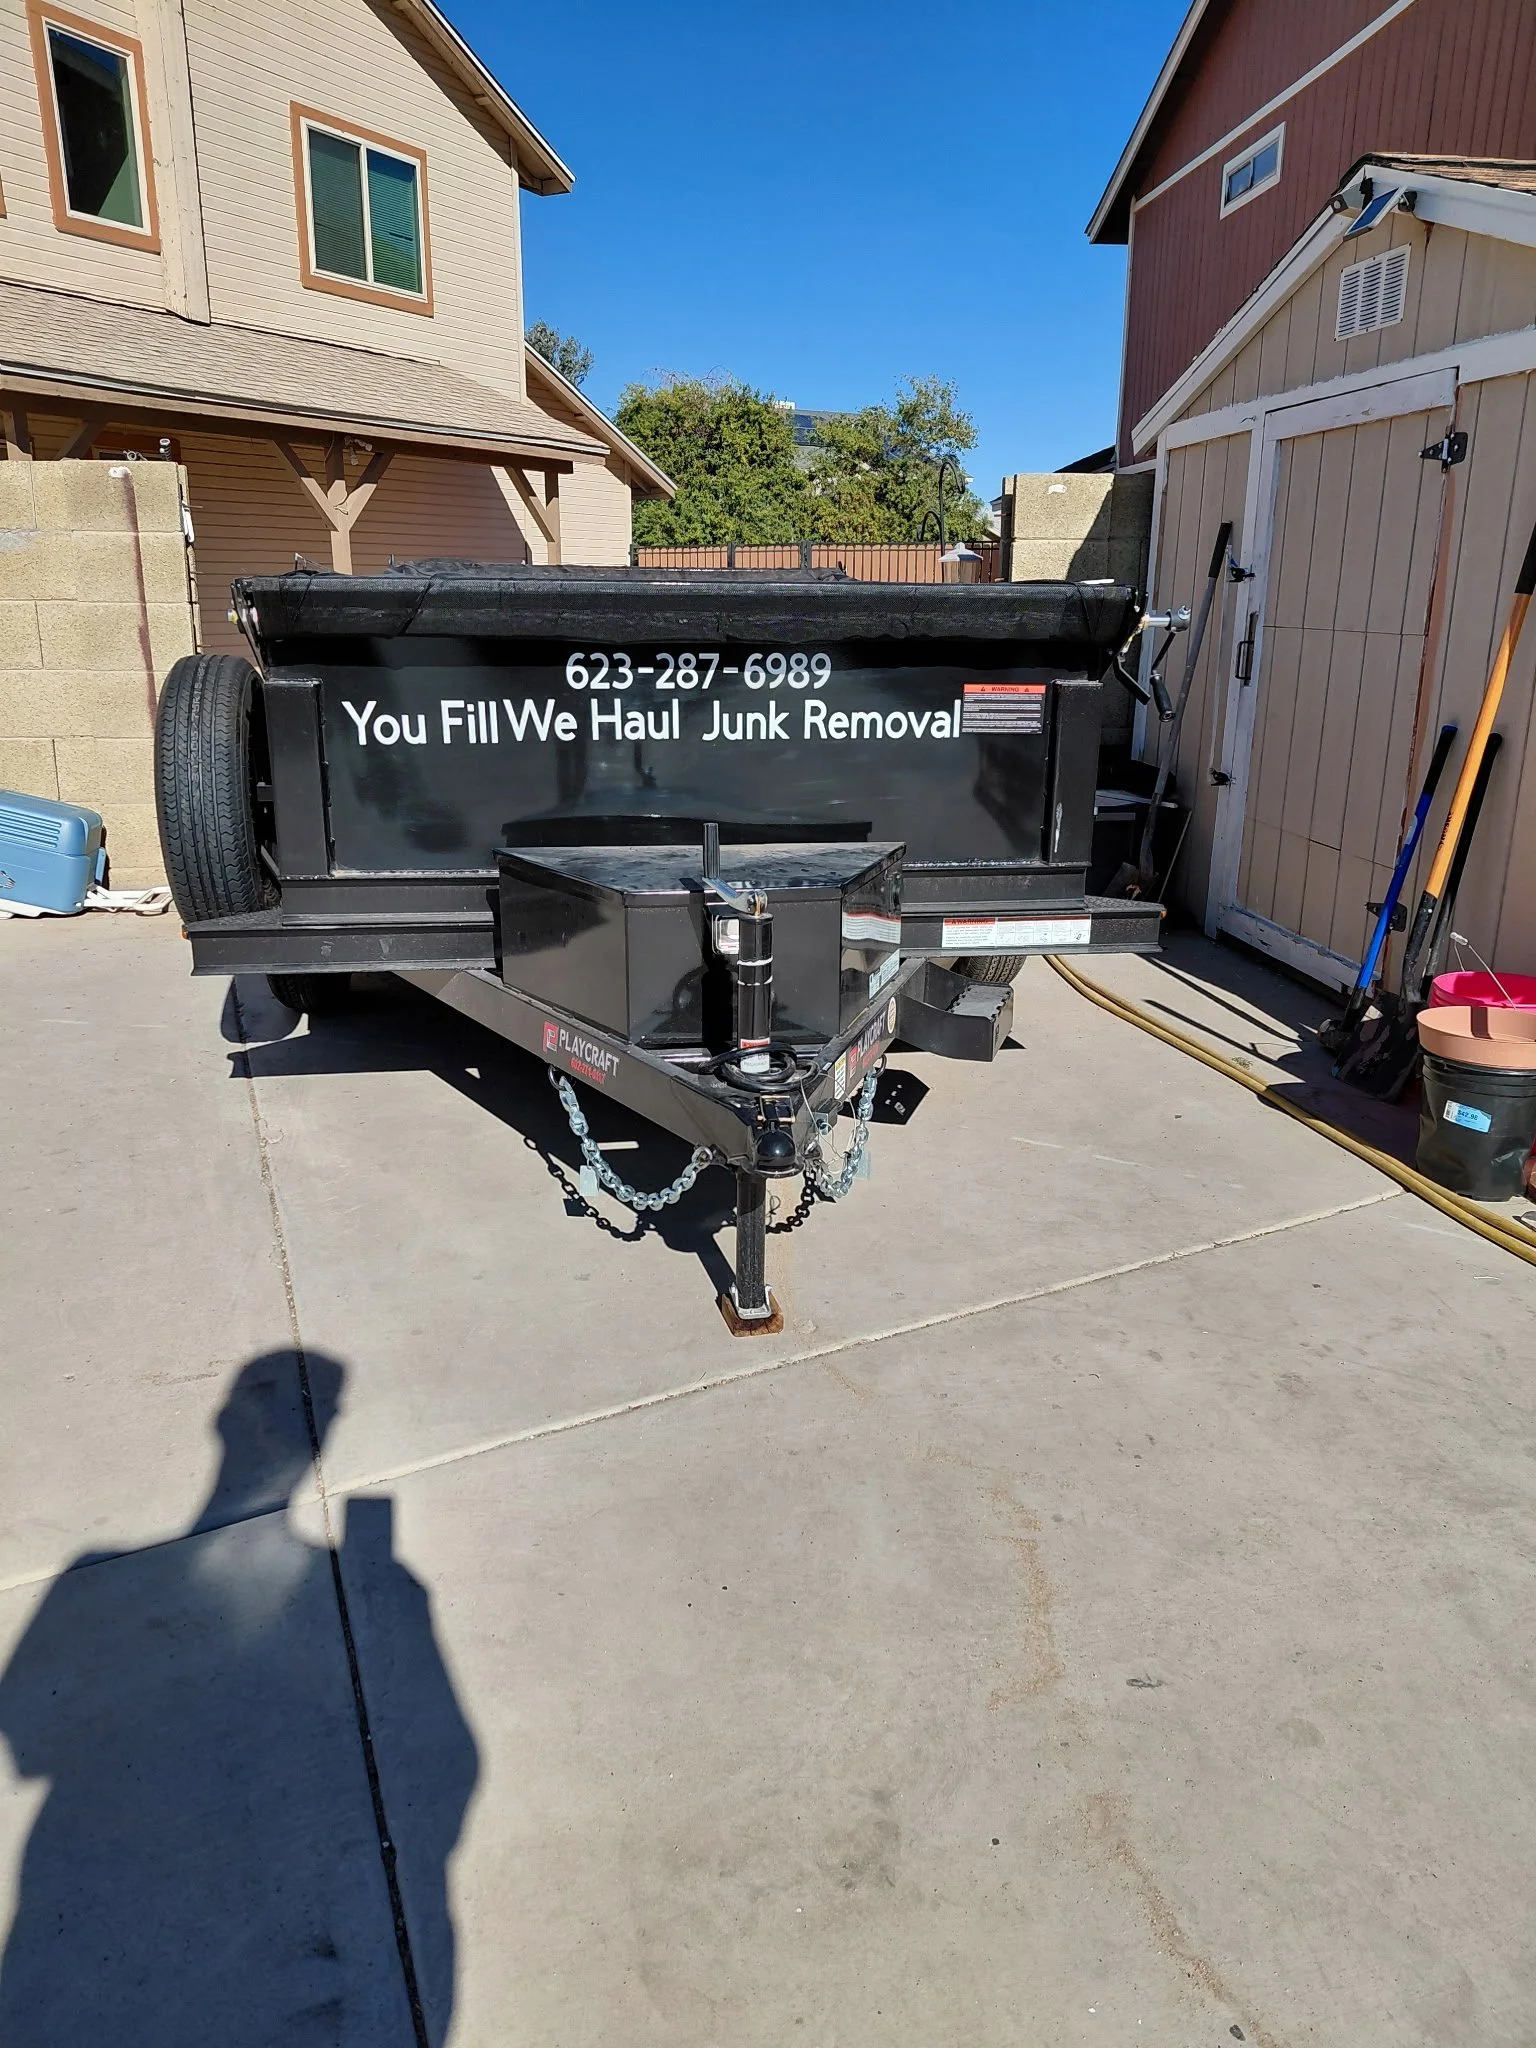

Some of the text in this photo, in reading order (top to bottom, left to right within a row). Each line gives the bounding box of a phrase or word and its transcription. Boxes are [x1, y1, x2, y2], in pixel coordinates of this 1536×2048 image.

[565, 652, 832, 690] 623-287-6989
[341, 700, 427, 745] You
[440, 699, 499, 744] Fill
[502, 698, 578, 742] We
[591, 697, 680, 741] Haul
[702, 699, 790, 741] Junk
[803, 698, 961, 740] Removal
[559, 1028, 620, 1077] PLAYCRAFT
[856, 1011, 886, 1062] PLAYCRAFT
